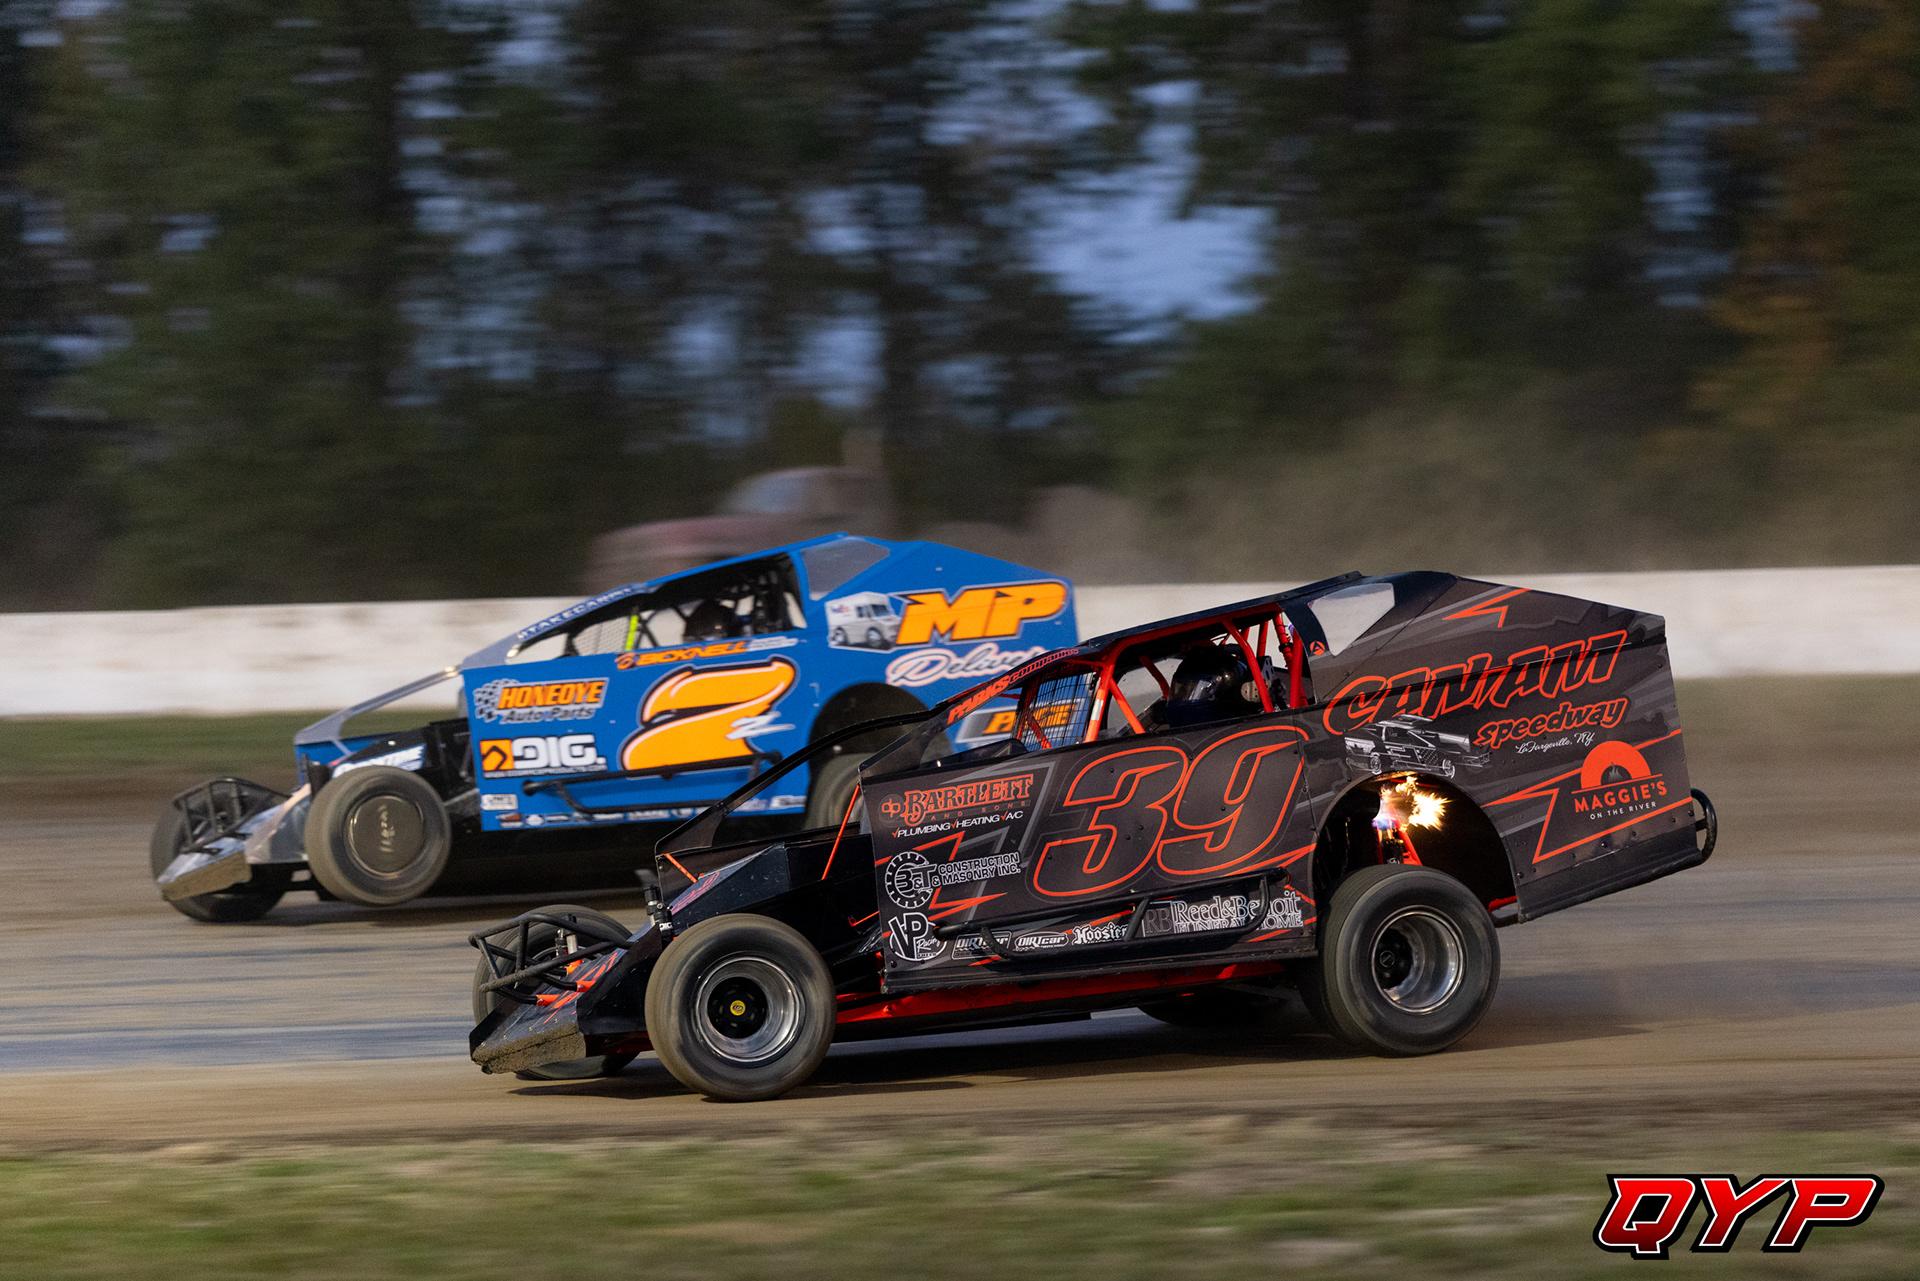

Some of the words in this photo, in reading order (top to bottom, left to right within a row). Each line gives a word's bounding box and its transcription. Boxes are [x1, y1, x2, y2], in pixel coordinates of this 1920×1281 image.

[895, 581, 1067, 646] MP
[497, 680, 605, 709] HONEOYE
[502, 710, 544, 722] Auto
[549, 707, 593, 720] Parts
[619, 656, 799, 775] 2
[1473, 698, 1628, 749] speedway
[900, 774, 1033, 826] BARTLETT
[931, 811, 963, 821] AND
[981, 801, 1026, 813] SONS
[1033, 725, 1309, 896] 39
[1574, 781, 1667, 813] MAGGIE'S
[1590, 812, 1603, 820] ON
[1607, 807, 1624, 817] THE
[1629, 801, 1656, 813] RIVER
[897, 823, 951, 838] PLUMBING
[955, 815, 1000, 828] HEATING
[931, 875, 942, 887] &
[942, 866, 997, 886] MASONRY
[998, 863, 1021, 877] INC.
[938, 851, 1020, 875] CONSTRUCTION
[888, 912, 929, 959] VP
[1074, 924, 1128, 944] Hoosier
